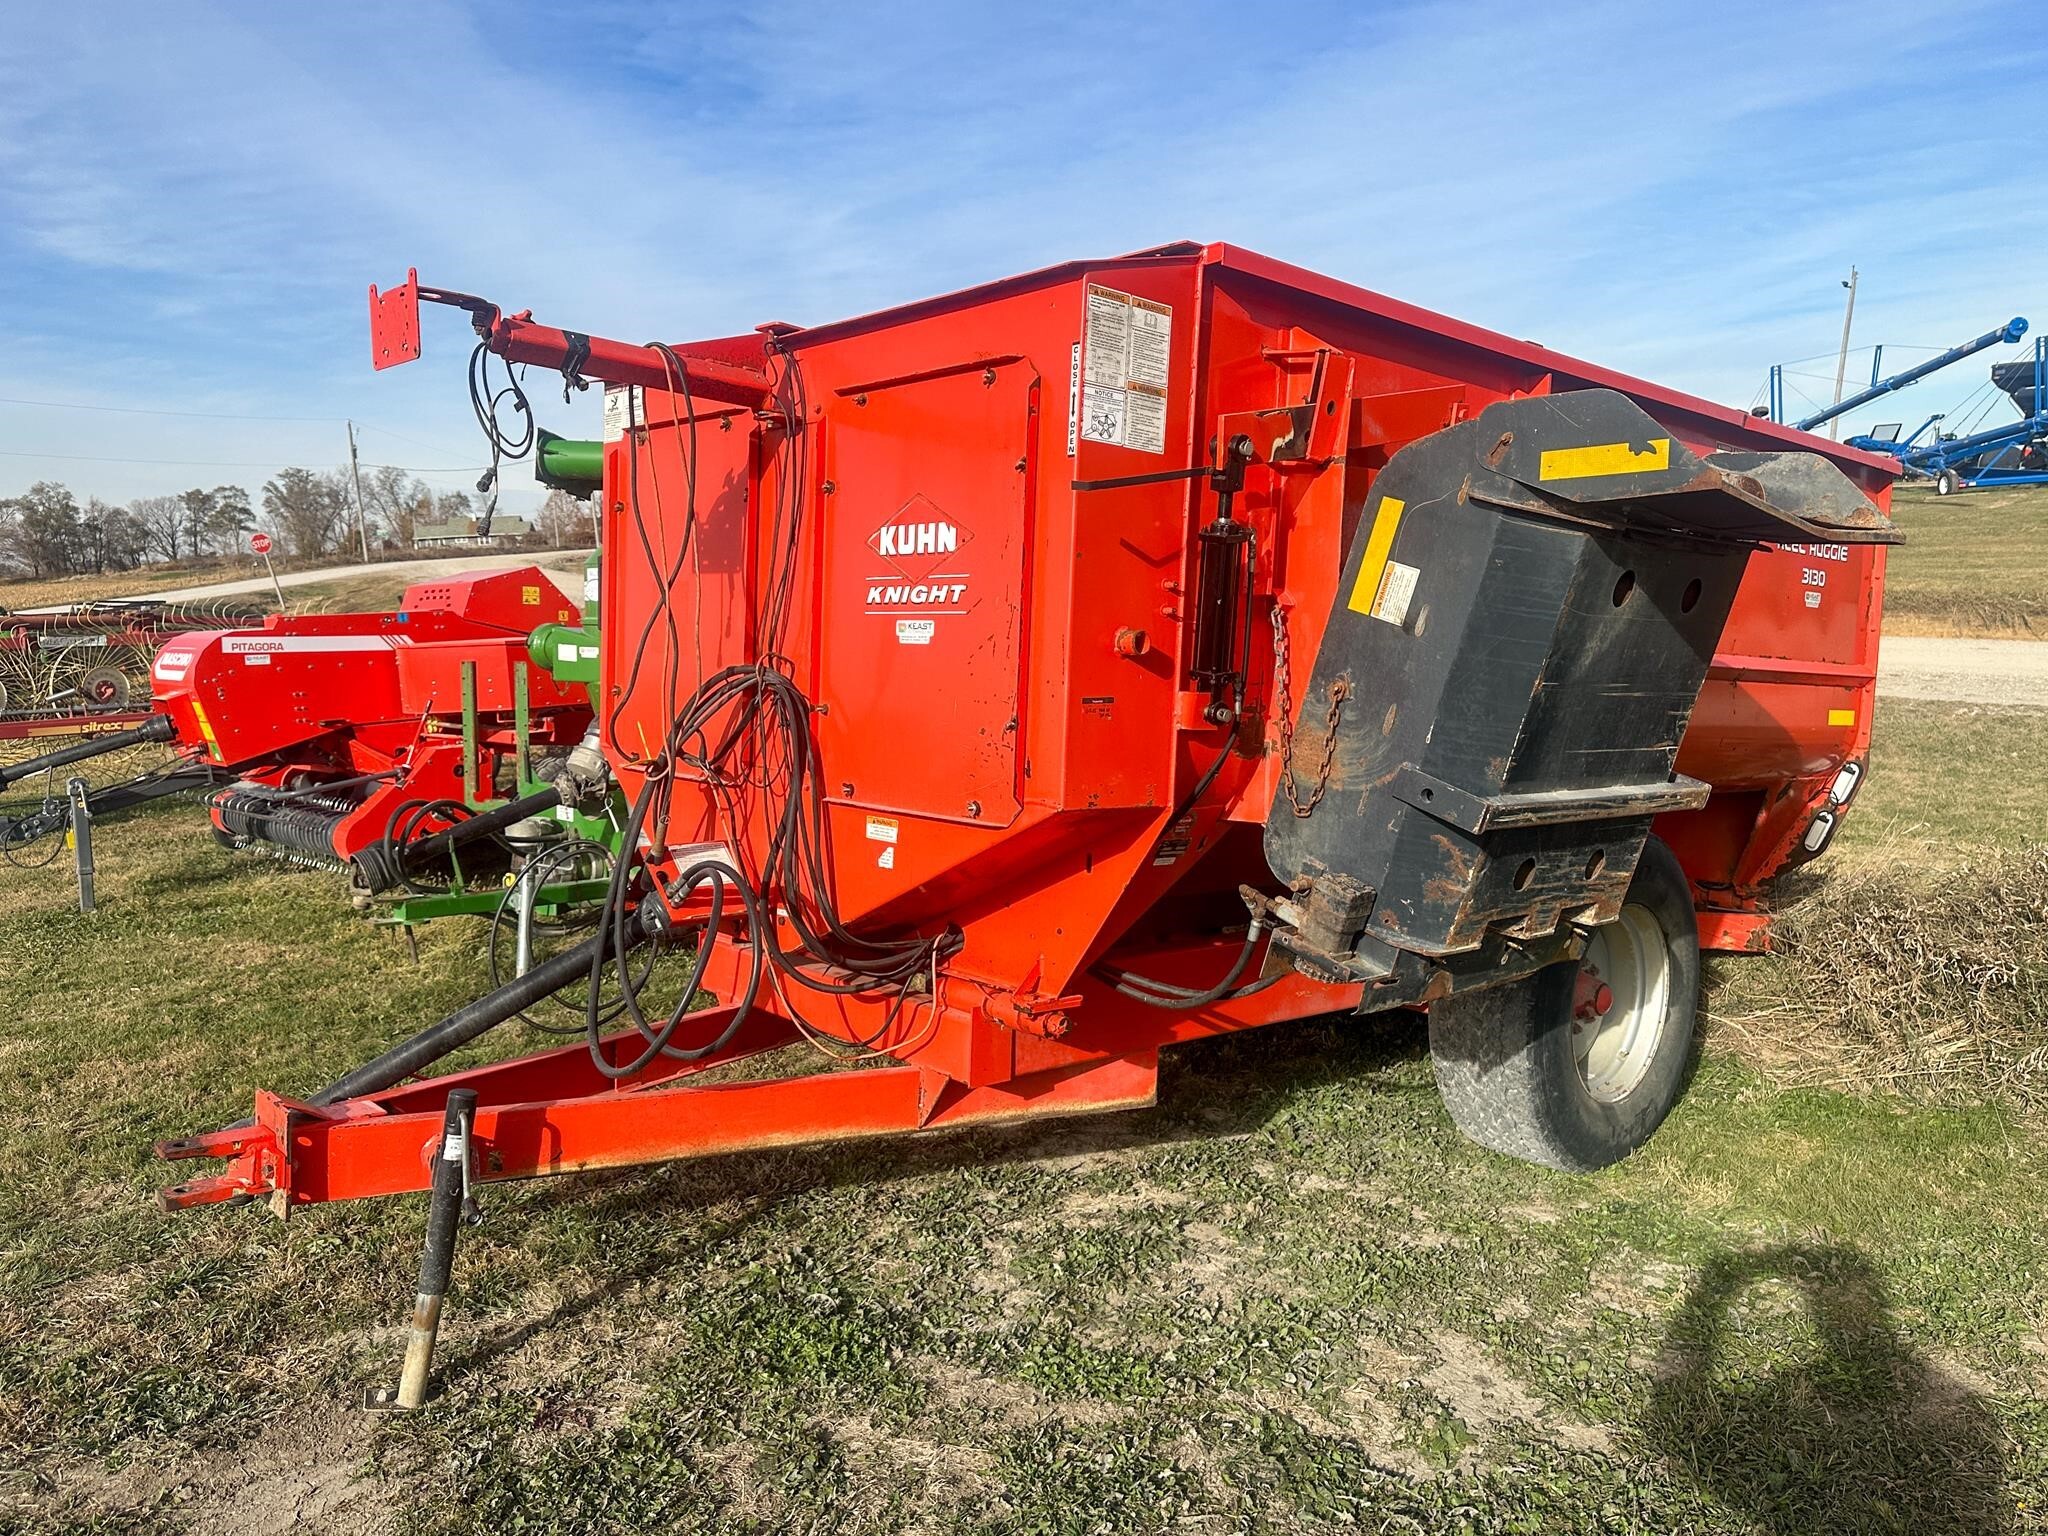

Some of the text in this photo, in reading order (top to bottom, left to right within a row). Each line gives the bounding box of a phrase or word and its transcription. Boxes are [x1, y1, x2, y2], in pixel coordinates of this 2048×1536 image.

[1094, 390, 1114, 399] NOTICE
[1068, 421, 1076, 453] OPEN
[251, 539, 270, 549] STOP
[879, 521, 957, 556] KUHN
[1809, 544, 1849, 562] HUGGIE
[1801, 567, 1826, 587] 3130
[866, 584, 967, 604] KNIGHT
[908, 622, 933, 630] KEAST
[231, 642, 284, 652] PITAGORA
[81, 722, 123, 733] sitrex
